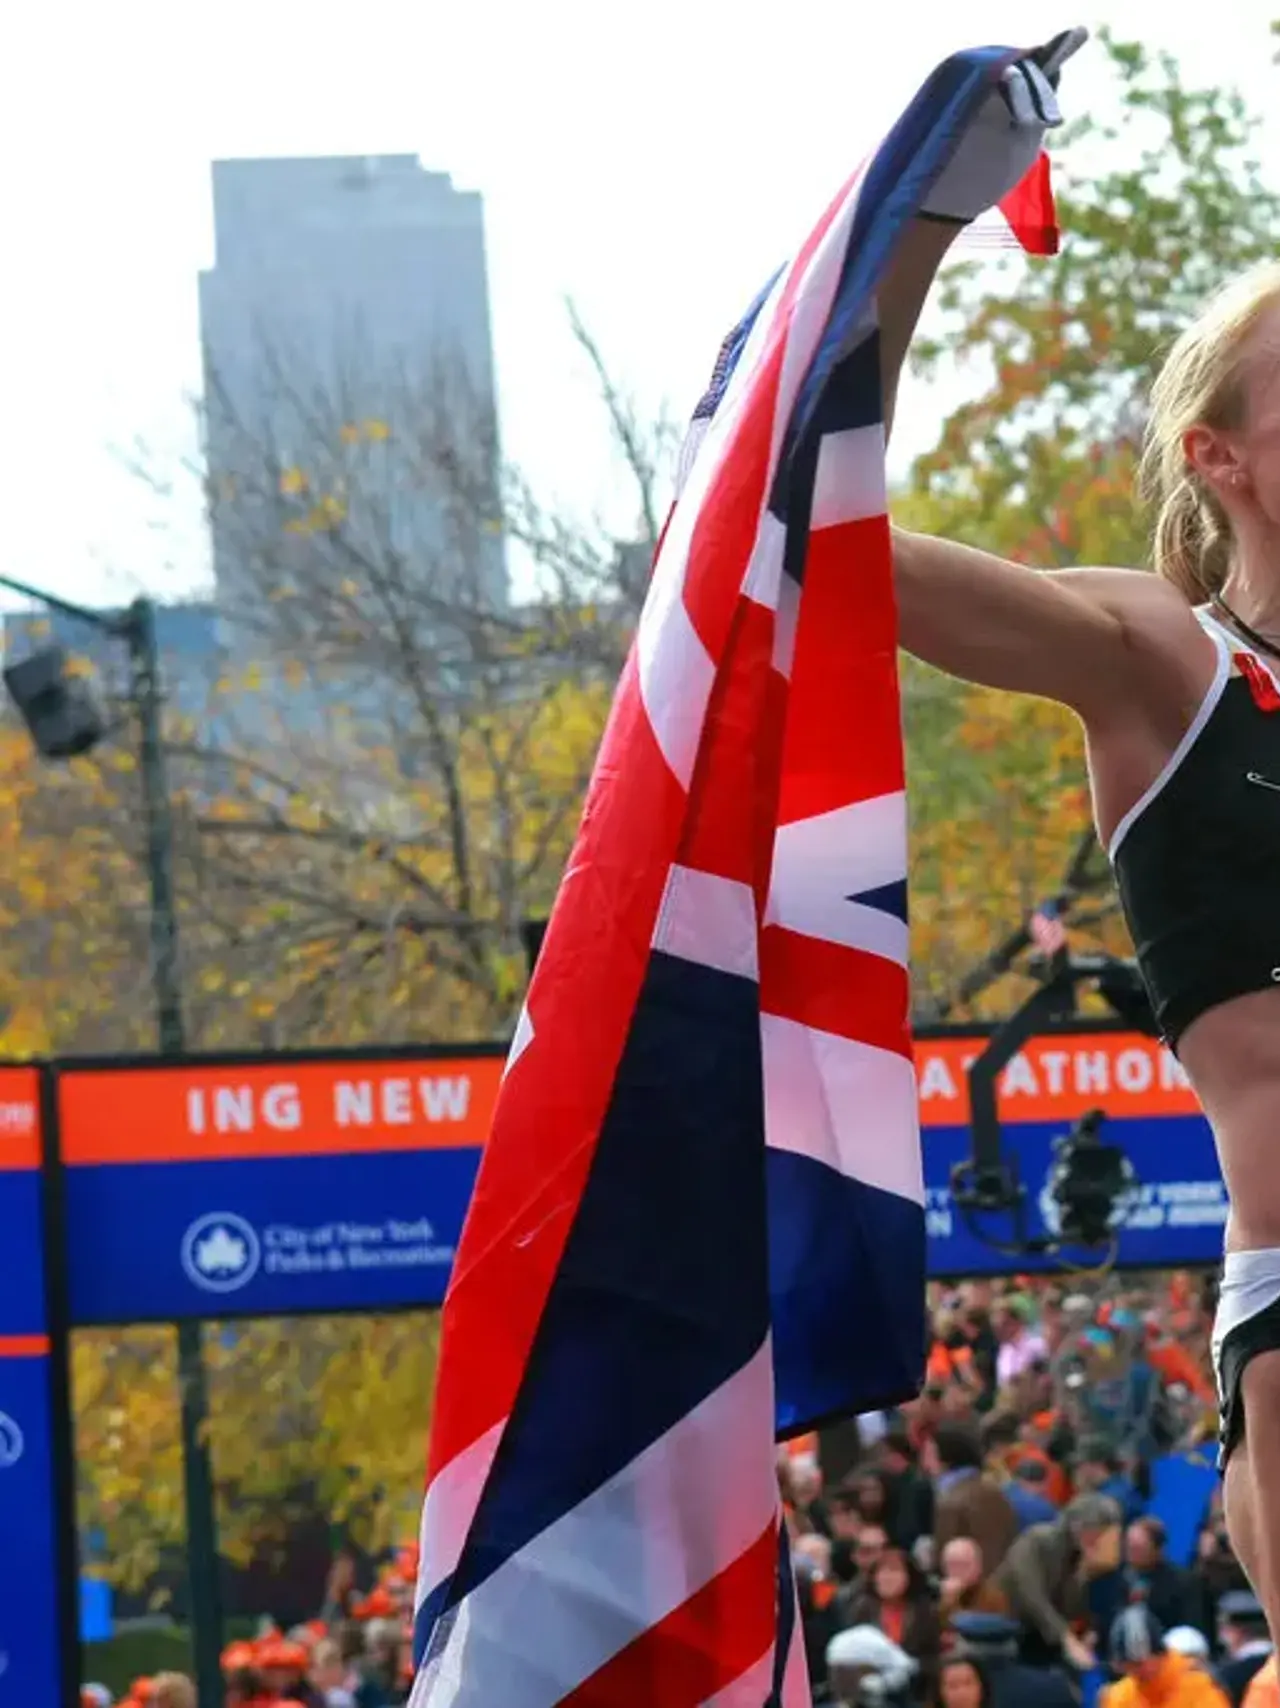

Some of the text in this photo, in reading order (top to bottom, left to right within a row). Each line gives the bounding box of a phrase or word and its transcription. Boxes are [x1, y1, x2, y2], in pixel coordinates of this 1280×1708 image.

[187, 1083, 302, 1134] ING
[333, 1075, 470, 1127] NEW
[337, 1221, 384, 1243] New
[387, 1217, 434, 1240] York
